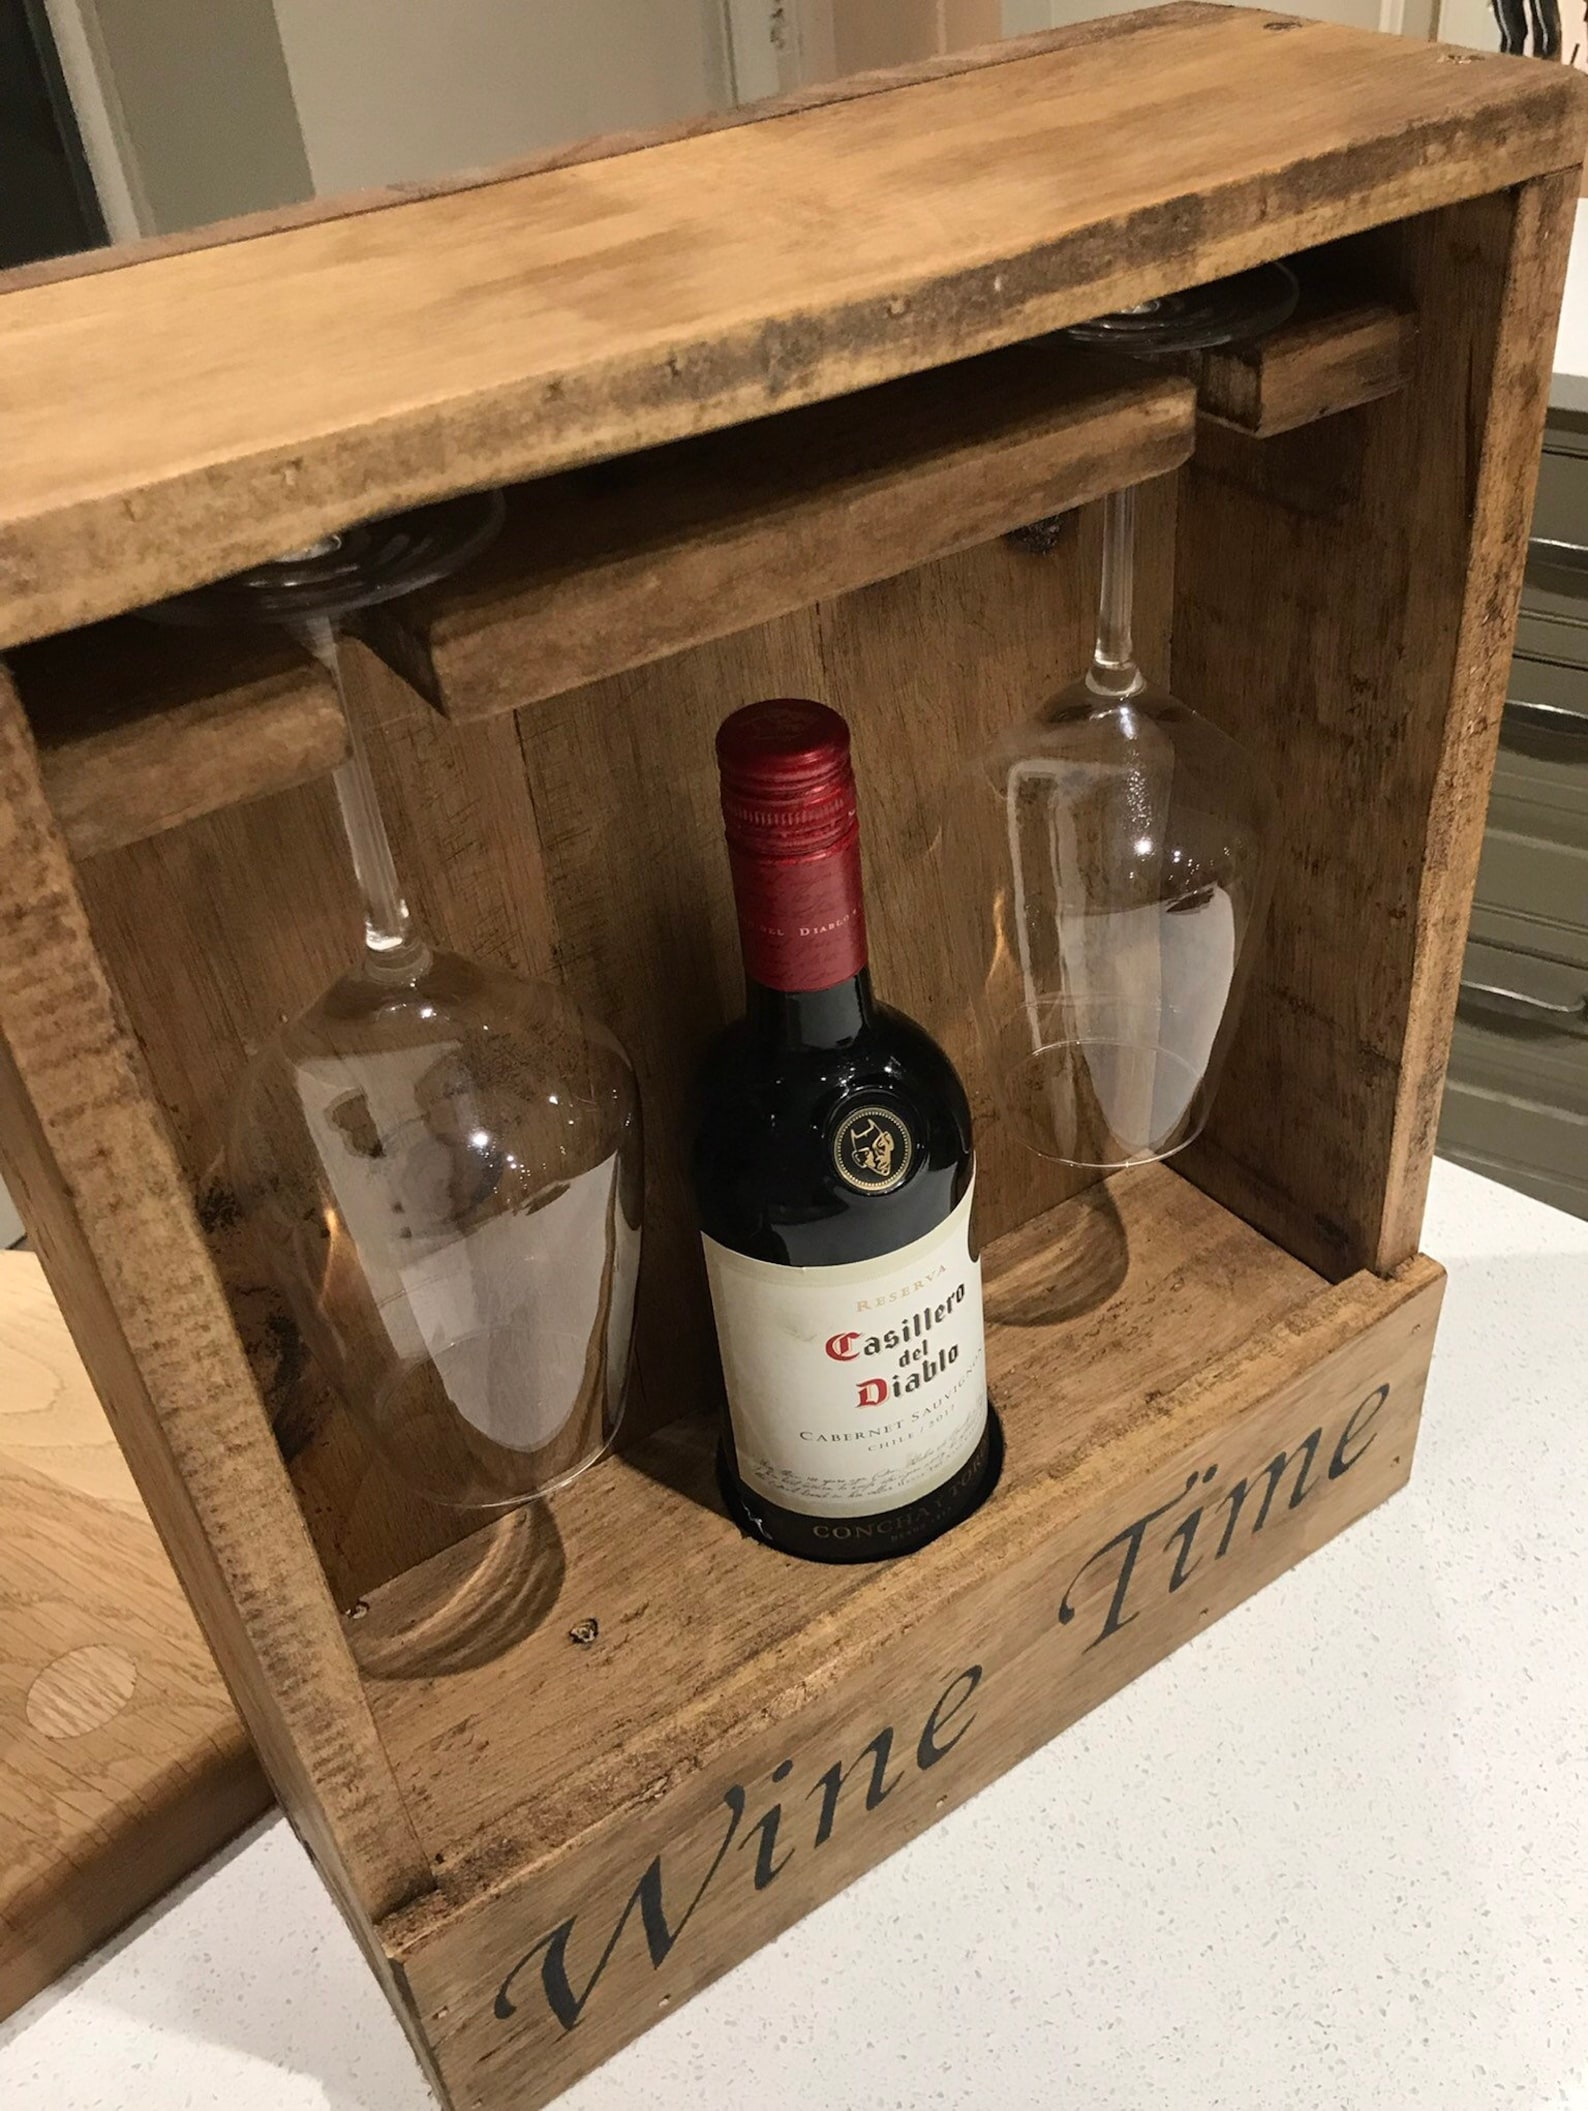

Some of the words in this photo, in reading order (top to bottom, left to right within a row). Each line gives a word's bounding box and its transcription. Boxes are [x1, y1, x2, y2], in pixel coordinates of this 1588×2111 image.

[799, 914, 850, 936] DIABLO
[856, 1264, 947, 1312] RESERVA
[825, 1283, 966, 1362] Casillero
[899, 1339, 929, 1368] del
[855, 1344, 959, 1408] Diablo
[799, 1418, 905, 1443] CABERNET
[867, 1432, 914, 1452] CHILE
[812, 1507, 932, 1540] CONCHA
[493, 1664, 983, 2031] Wine
[1058, 1383, 1390, 1655] Time
